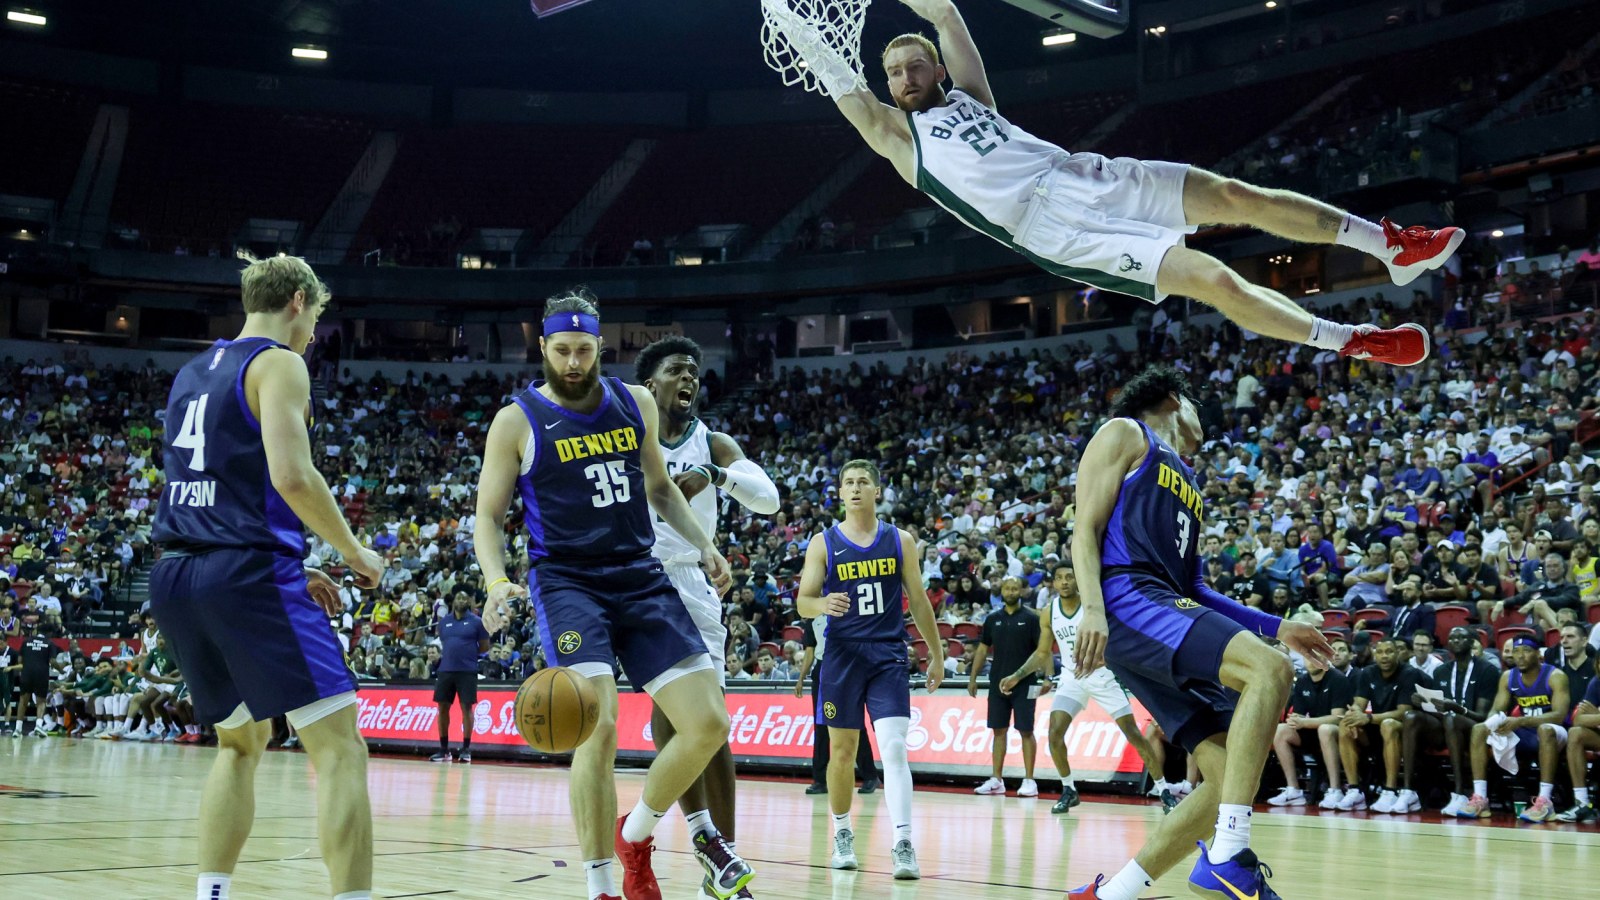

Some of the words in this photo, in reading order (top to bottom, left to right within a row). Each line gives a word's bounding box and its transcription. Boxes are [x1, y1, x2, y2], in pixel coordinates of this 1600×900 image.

[959, 120, 1009, 157] 27
[171, 393, 208, 471] 4
[555, 426, 639, 463] DENVER
[169, 481, 216, 507] TYSN
[583, 459, 631, 508] 35
[1157, 462, 1204, 522] DENVE
[836, 557, 896, 581] DENVER
[857, 581, 885, 616] 21
[1056, 625, 1079, 640] BUC
